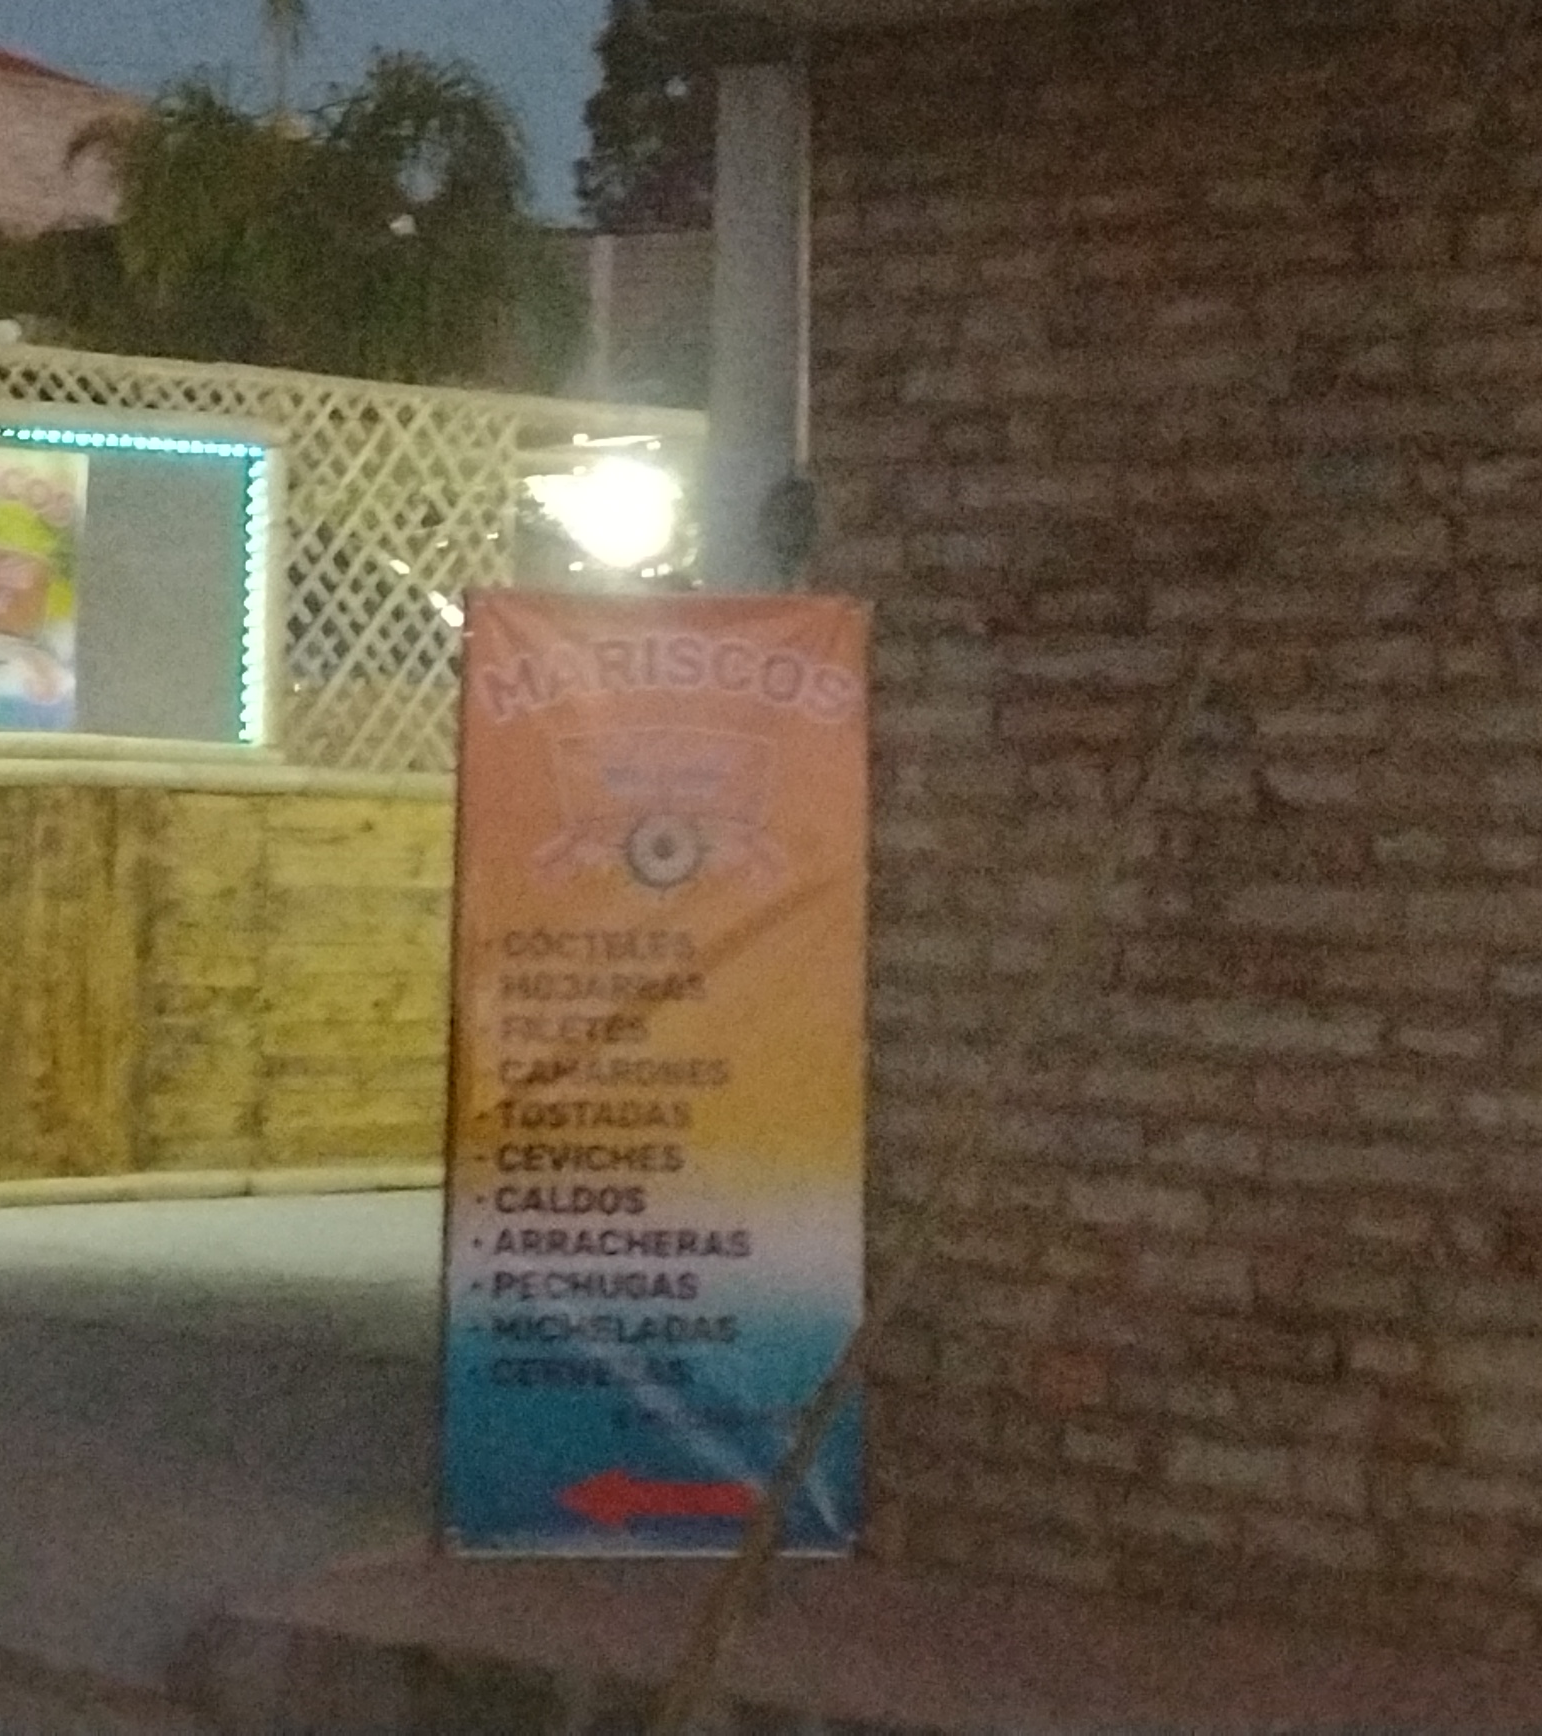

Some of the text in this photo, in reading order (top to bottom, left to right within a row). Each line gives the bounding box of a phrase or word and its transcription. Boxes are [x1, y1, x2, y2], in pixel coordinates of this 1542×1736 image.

[478, 634, 861, 720] MARISCOS
[497, 1101, 693, 1129] TOSTADAS
[497, 1144, 686, 1173] CEVICHES
[494, 1186, 647, 1215] CALDOS
[493, 1229, 753, 1258] ARRACHERAS
[491, 1272, 700, 1300] PECHUGAS
[491, 1315, 741, 1343] MICHELADAS
